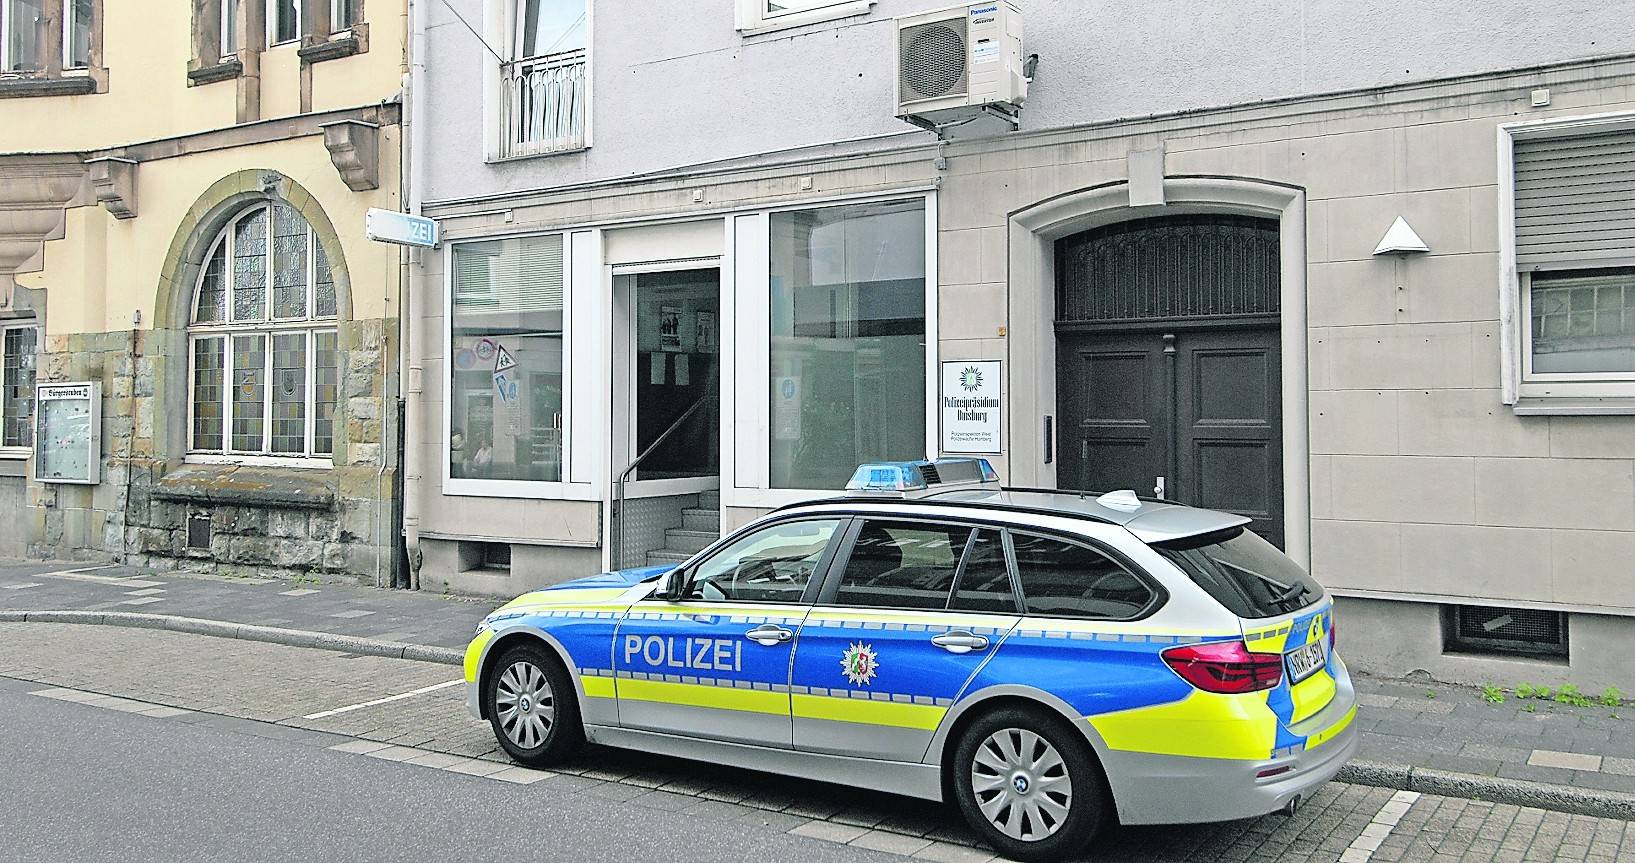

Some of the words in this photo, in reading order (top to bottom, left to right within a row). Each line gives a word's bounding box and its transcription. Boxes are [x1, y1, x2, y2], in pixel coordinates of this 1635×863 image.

[970, 6, 998, 16] Panasonic
[944, 396, 998, 411] Polizeipräsidium
[958, 410, 987, 423] Duisburg
[624, 635, 742, 672] POLIZEI
